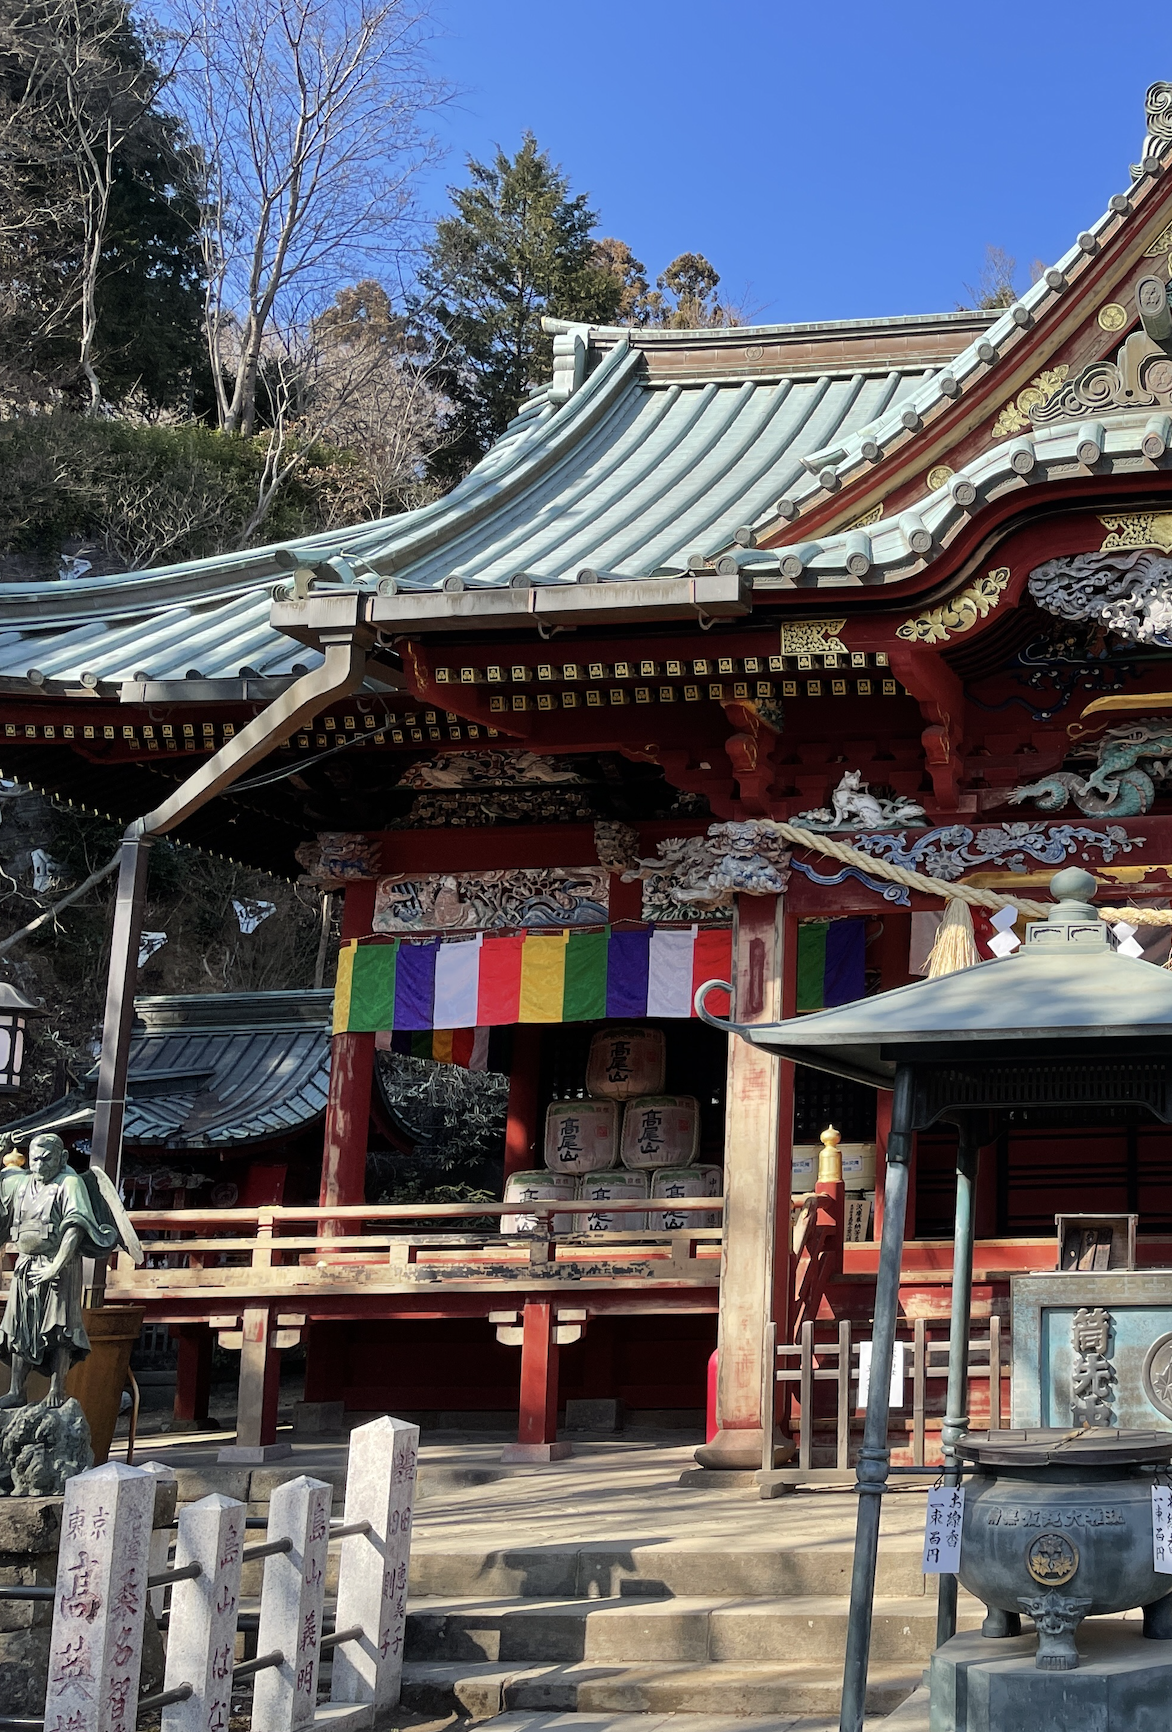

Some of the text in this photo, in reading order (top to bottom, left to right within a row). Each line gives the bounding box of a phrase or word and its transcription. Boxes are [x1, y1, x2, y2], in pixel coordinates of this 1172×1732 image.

[66, 1506, 110, 1541] 東京
[926, 1502, 945, 1563] 一束百円
[945, 1492, 963, 1548] お線香
